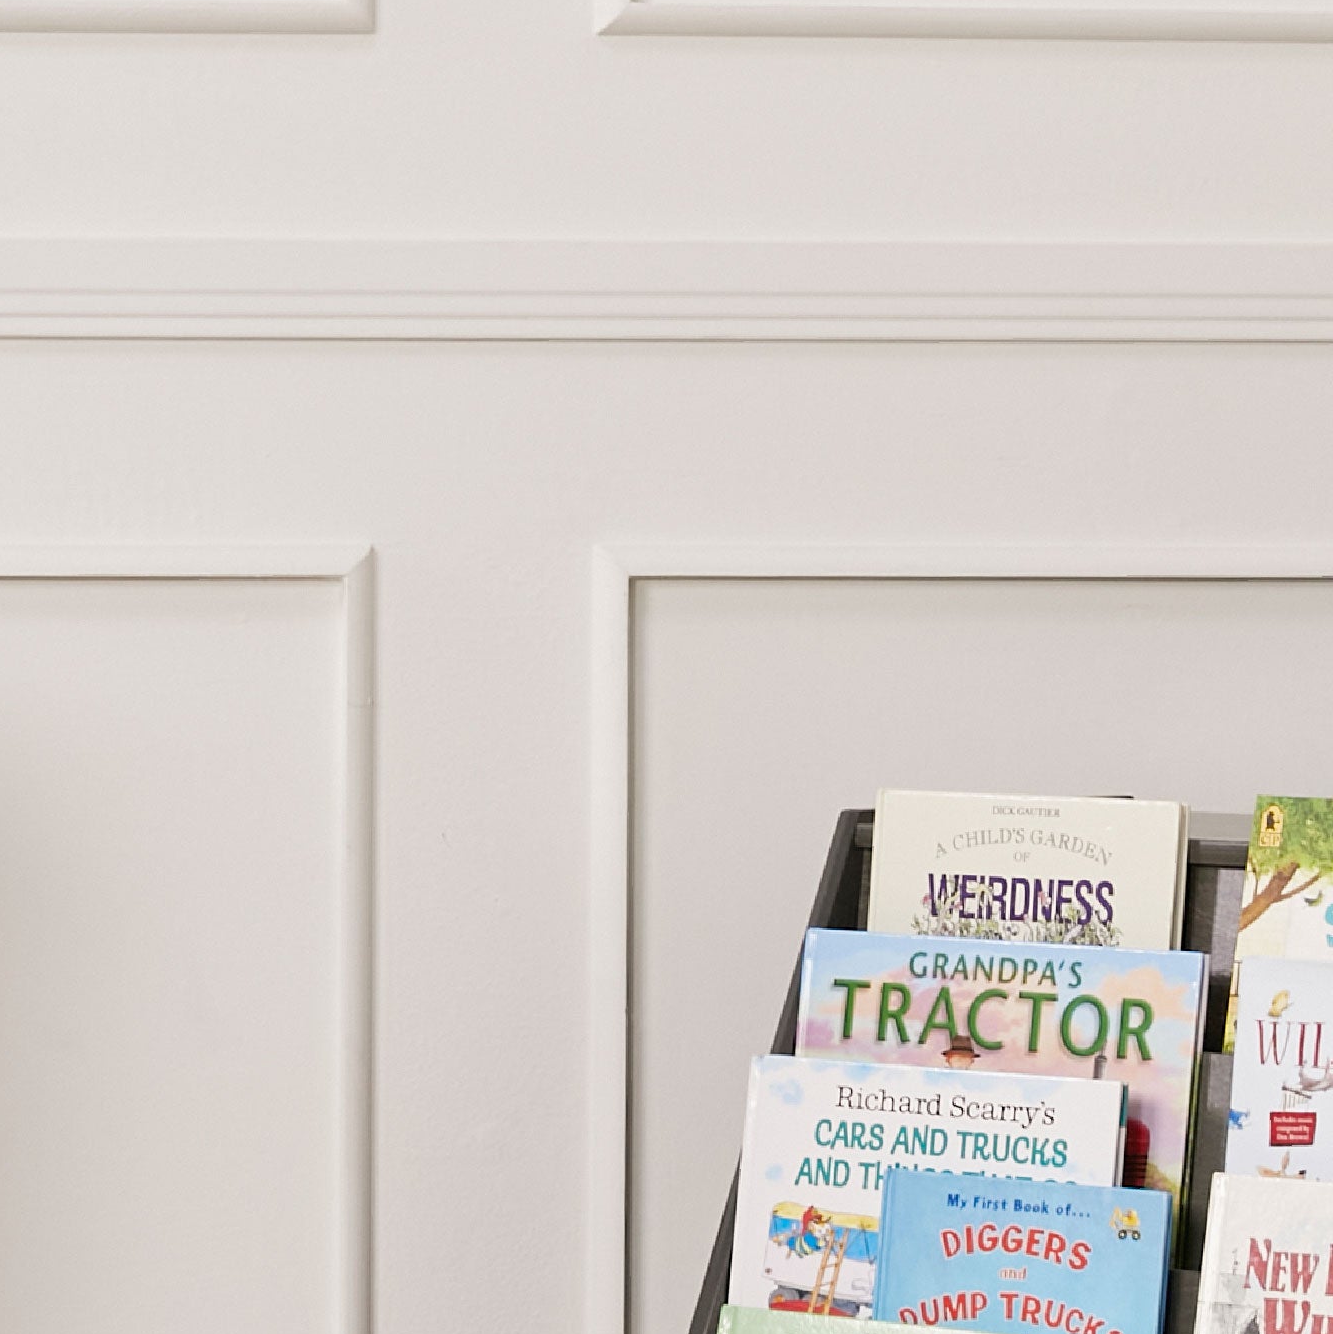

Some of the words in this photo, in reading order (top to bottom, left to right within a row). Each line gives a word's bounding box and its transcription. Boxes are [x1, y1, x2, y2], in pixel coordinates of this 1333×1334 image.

[935, 842, 948, 859] A
[953, 827, 1025, 851] CHILD'S
[1030, 829, 1113, 866] GARDEN
[1013, 850, 1032, 863] OF
[928, 873, 1115, 925] WEIRDNESS
[909, 951, 1083, 989] GRANDPA'S
[833, 978, 1155, 1061] TRACTOR
[835, 1084, 942, 1117] Richard
[949, 1095, 1056, 1129] Scarry's
[815, 1119, 884, 1151] CARS
[890, 1124, 948, 1157] AND
[957, 1130, 1069, 1167] TRUCKS
[794, 1156, 851, 1189] AND
[947, 1193, 968, 1210] My
[973, 1196, 1008, 1211] First
[1014, 1199, 1049, 1214] Book
[940, 1222, 1092, 1270] DIGGERS
[999, 1266, 1027, 1280] and
